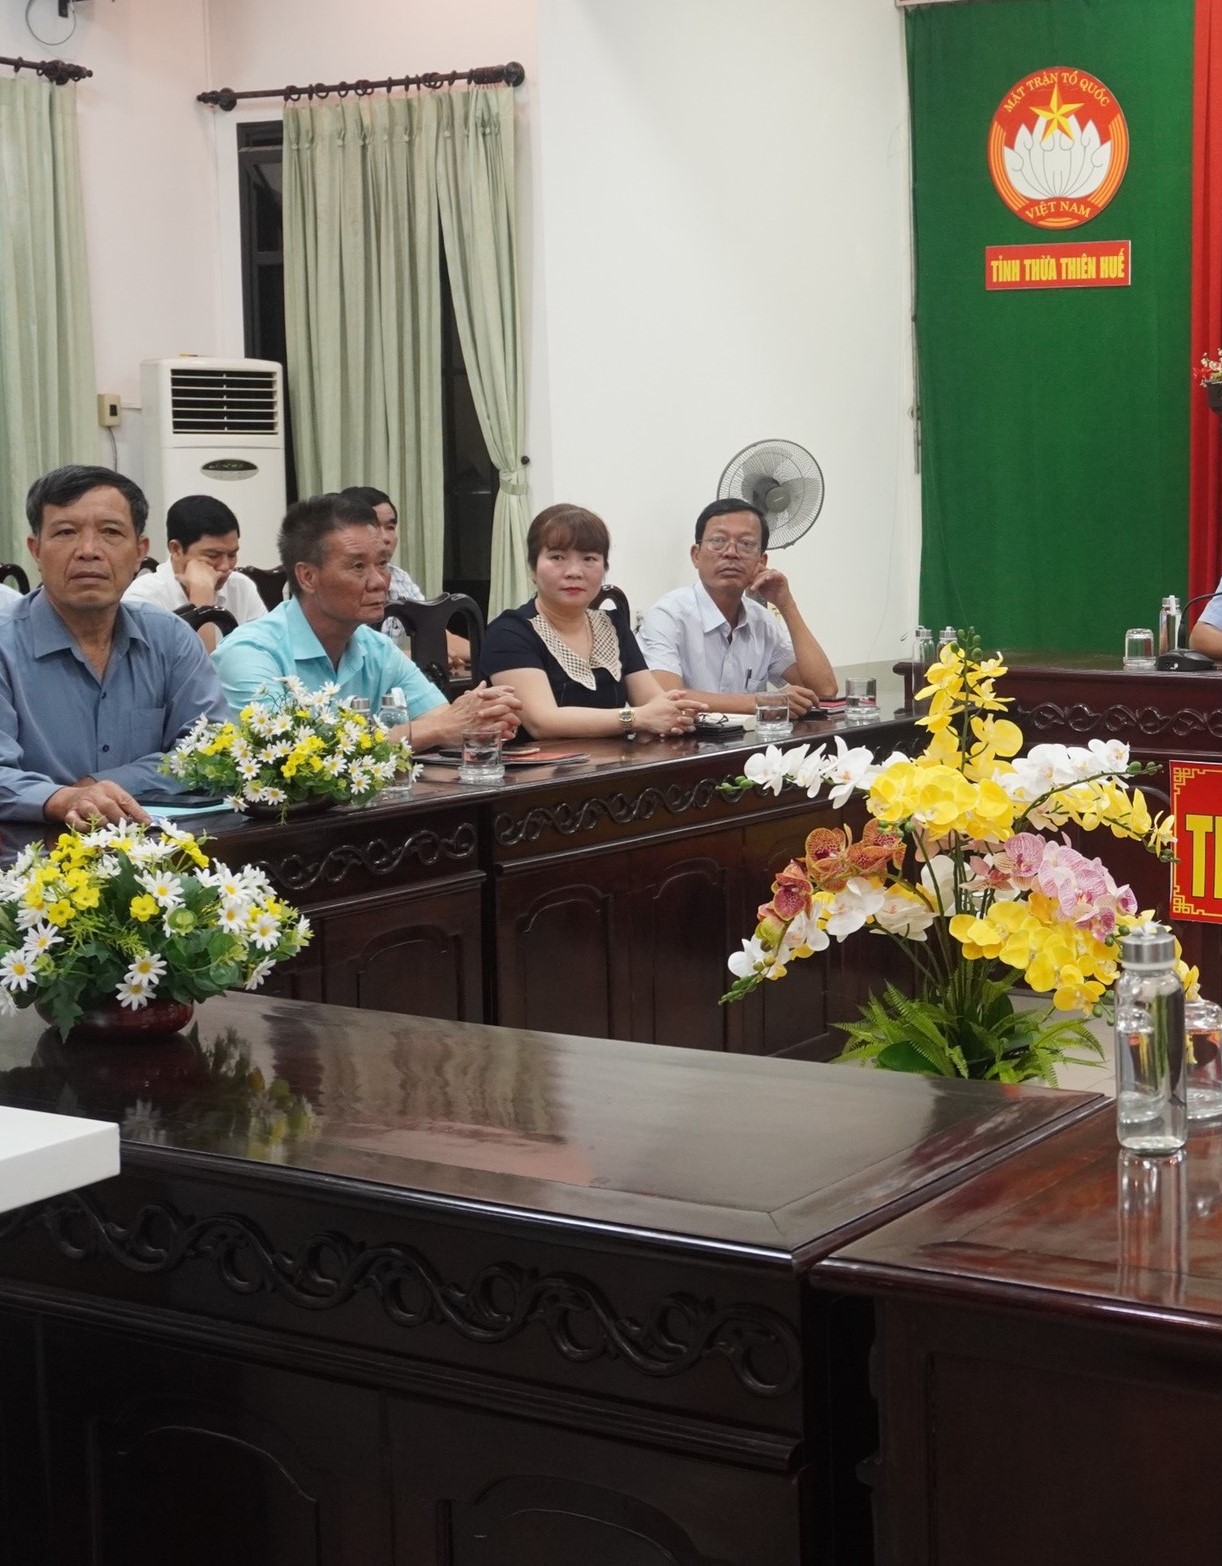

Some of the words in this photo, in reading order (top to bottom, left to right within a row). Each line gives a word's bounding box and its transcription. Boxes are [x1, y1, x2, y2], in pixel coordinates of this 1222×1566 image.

[1025, 201, 1057, 219] VIỆT
[1060, 200, 1092, 218] NAM
[1023, 254, 1057, 281] THỪA
[1060, 252, 1097, 280] THIÊN
[1100, 248, 1125, 279] HUẾ
